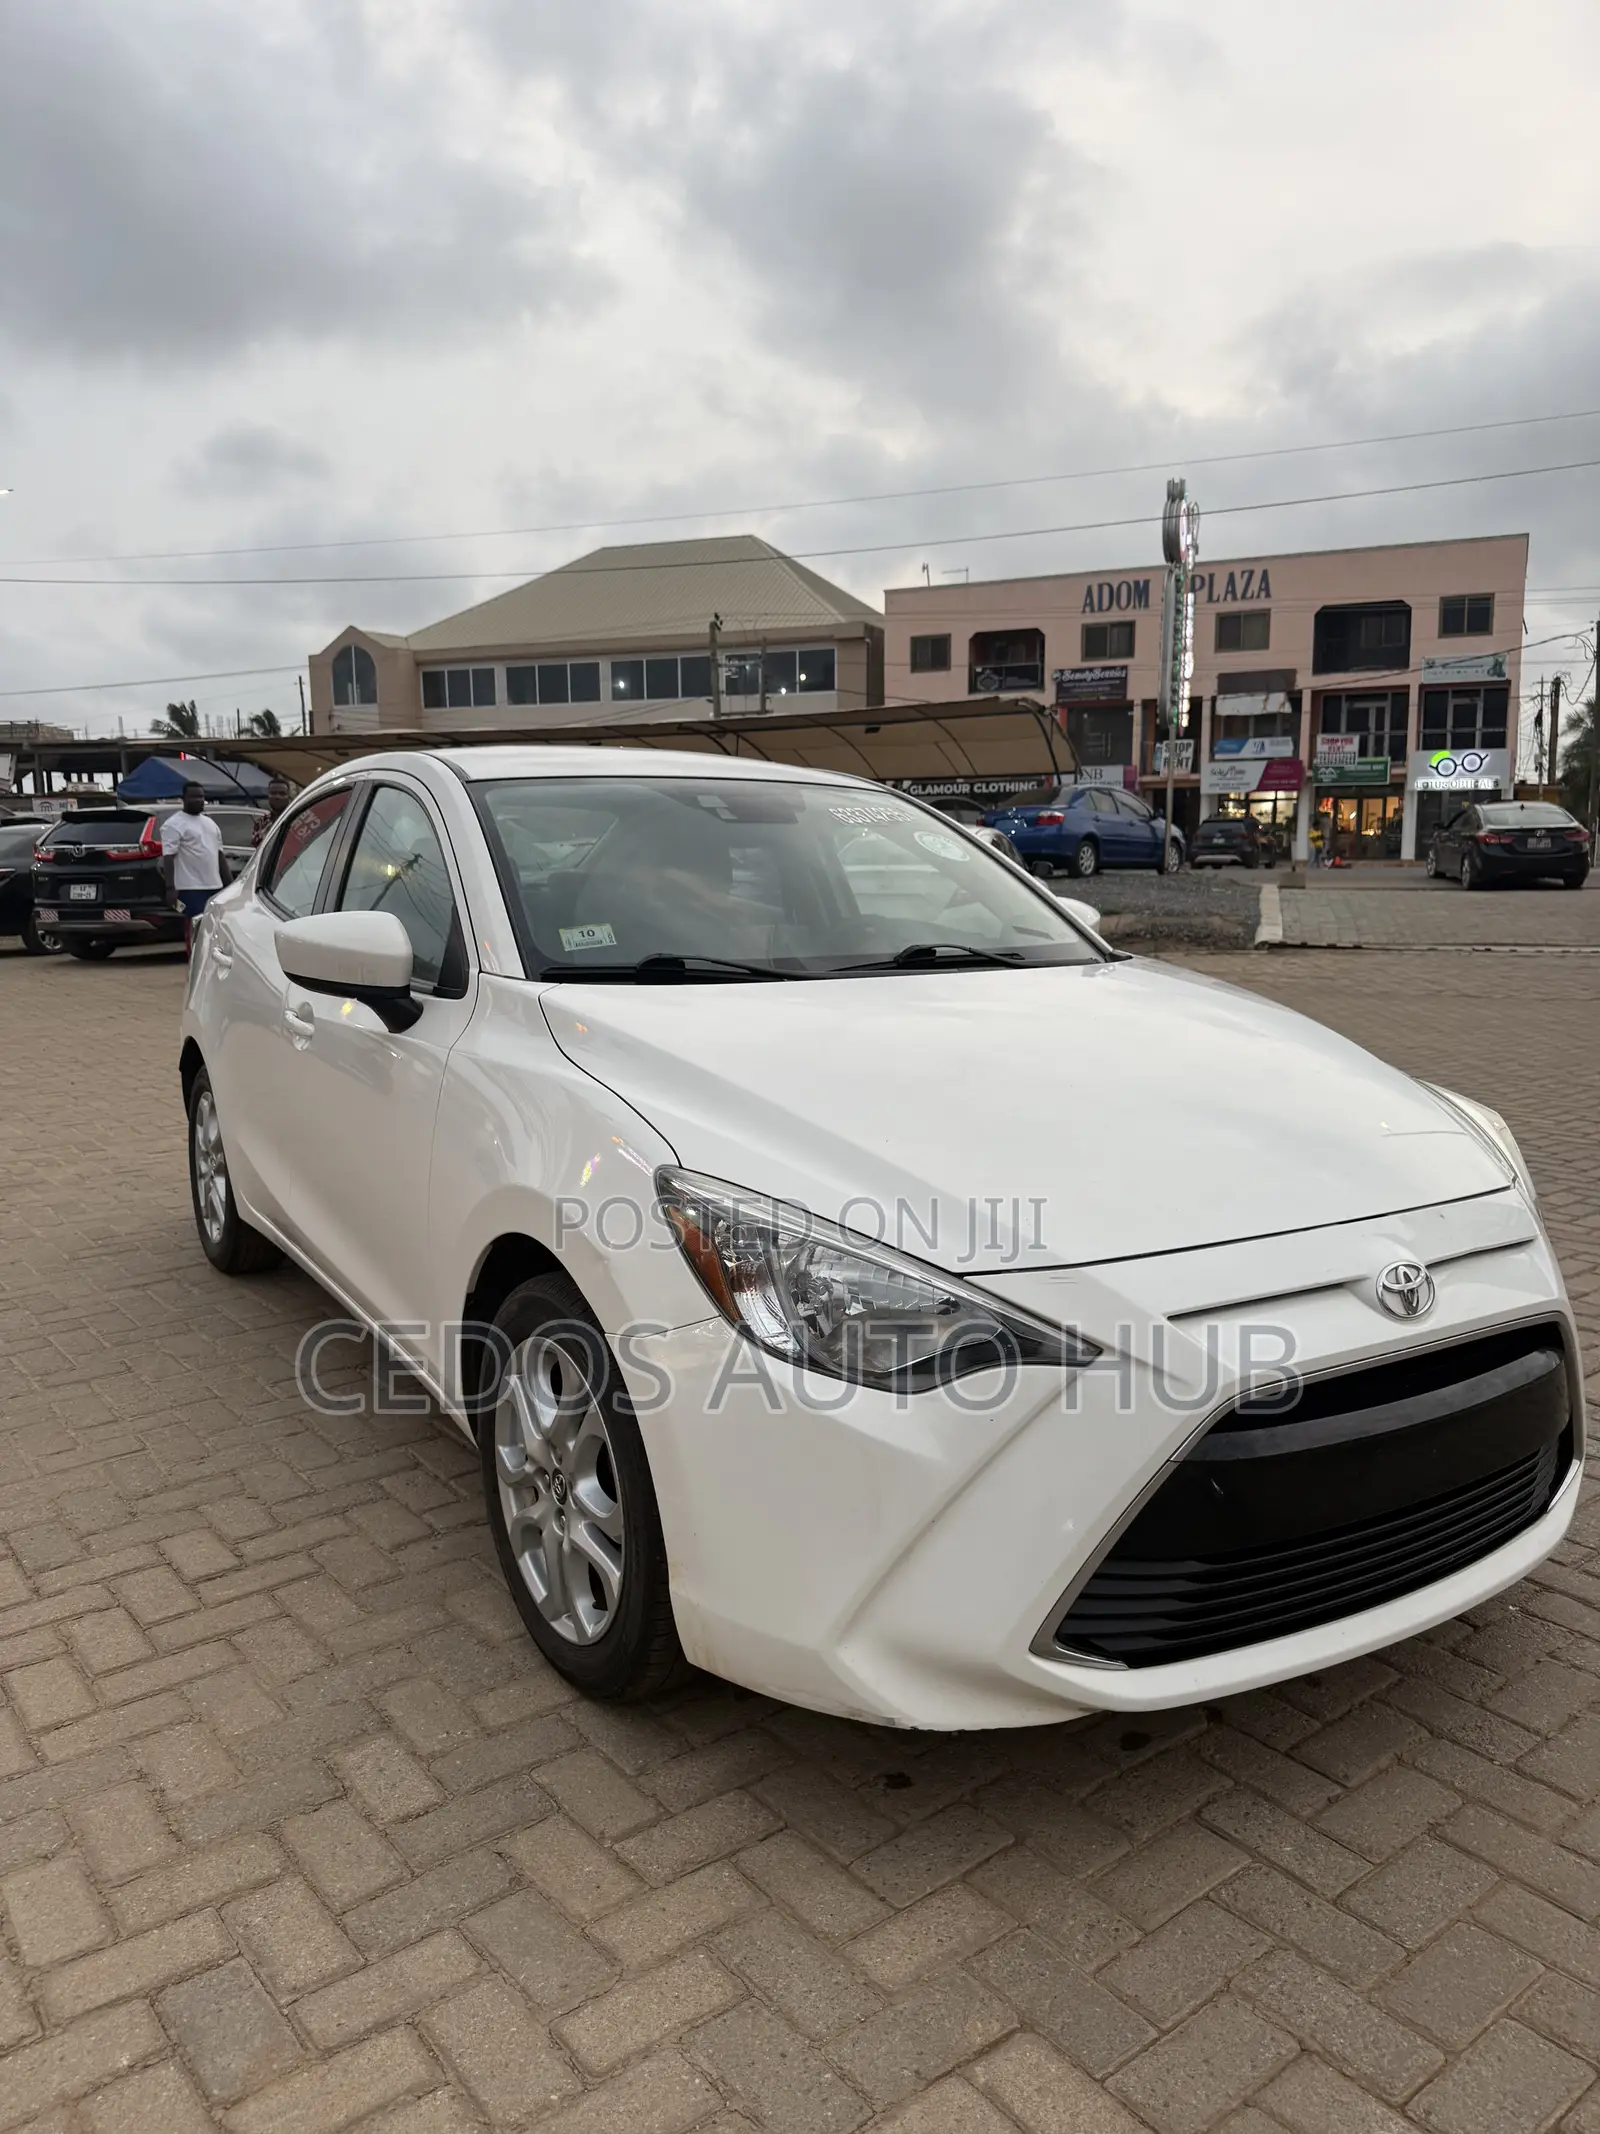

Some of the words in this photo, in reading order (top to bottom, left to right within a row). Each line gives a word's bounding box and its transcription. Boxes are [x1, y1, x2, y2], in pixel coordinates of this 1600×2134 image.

[1081, 579, 1150, 613] ADOM
[1191, 568, 1271, 604] PLAZA
[1164, 742, 1192, 753] SOP
[1163, 756, 1191, 769] RNT
[910, 783, 970, 795] GLAMOUR
[973, 781, 1038, 793] CLOTHING
[1415, 780, 1448, 790] LOTUS
[578, 929, 596, 938] 10
